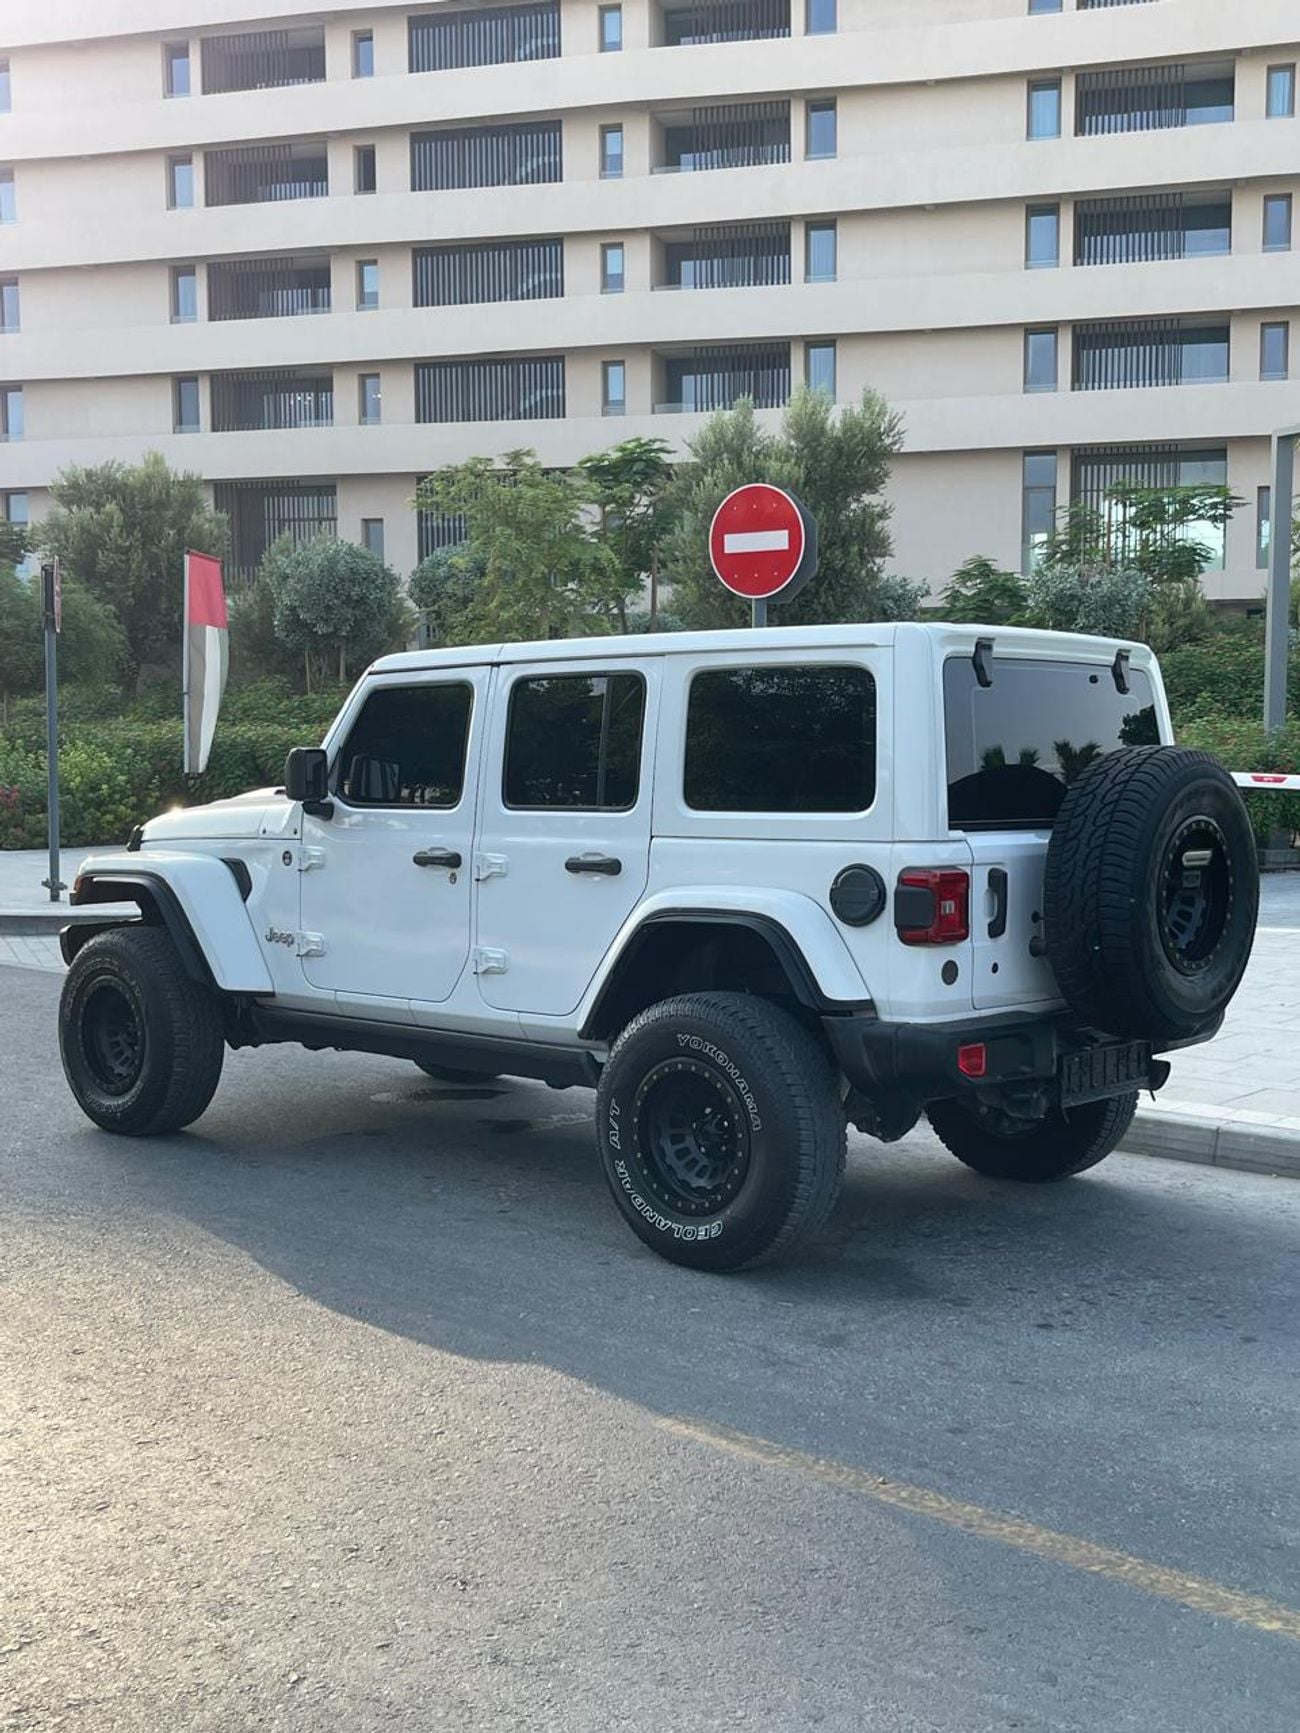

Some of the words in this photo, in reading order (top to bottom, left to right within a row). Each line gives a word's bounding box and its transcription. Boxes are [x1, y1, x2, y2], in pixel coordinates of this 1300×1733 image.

[265, 926, 295, 948] Jeep
[677, 1033, 762, 1131] YOKOHAMA
[609, 1097, 621, 1150] A/T
[614, 1160, 723, 1241] GEOLANDAR
